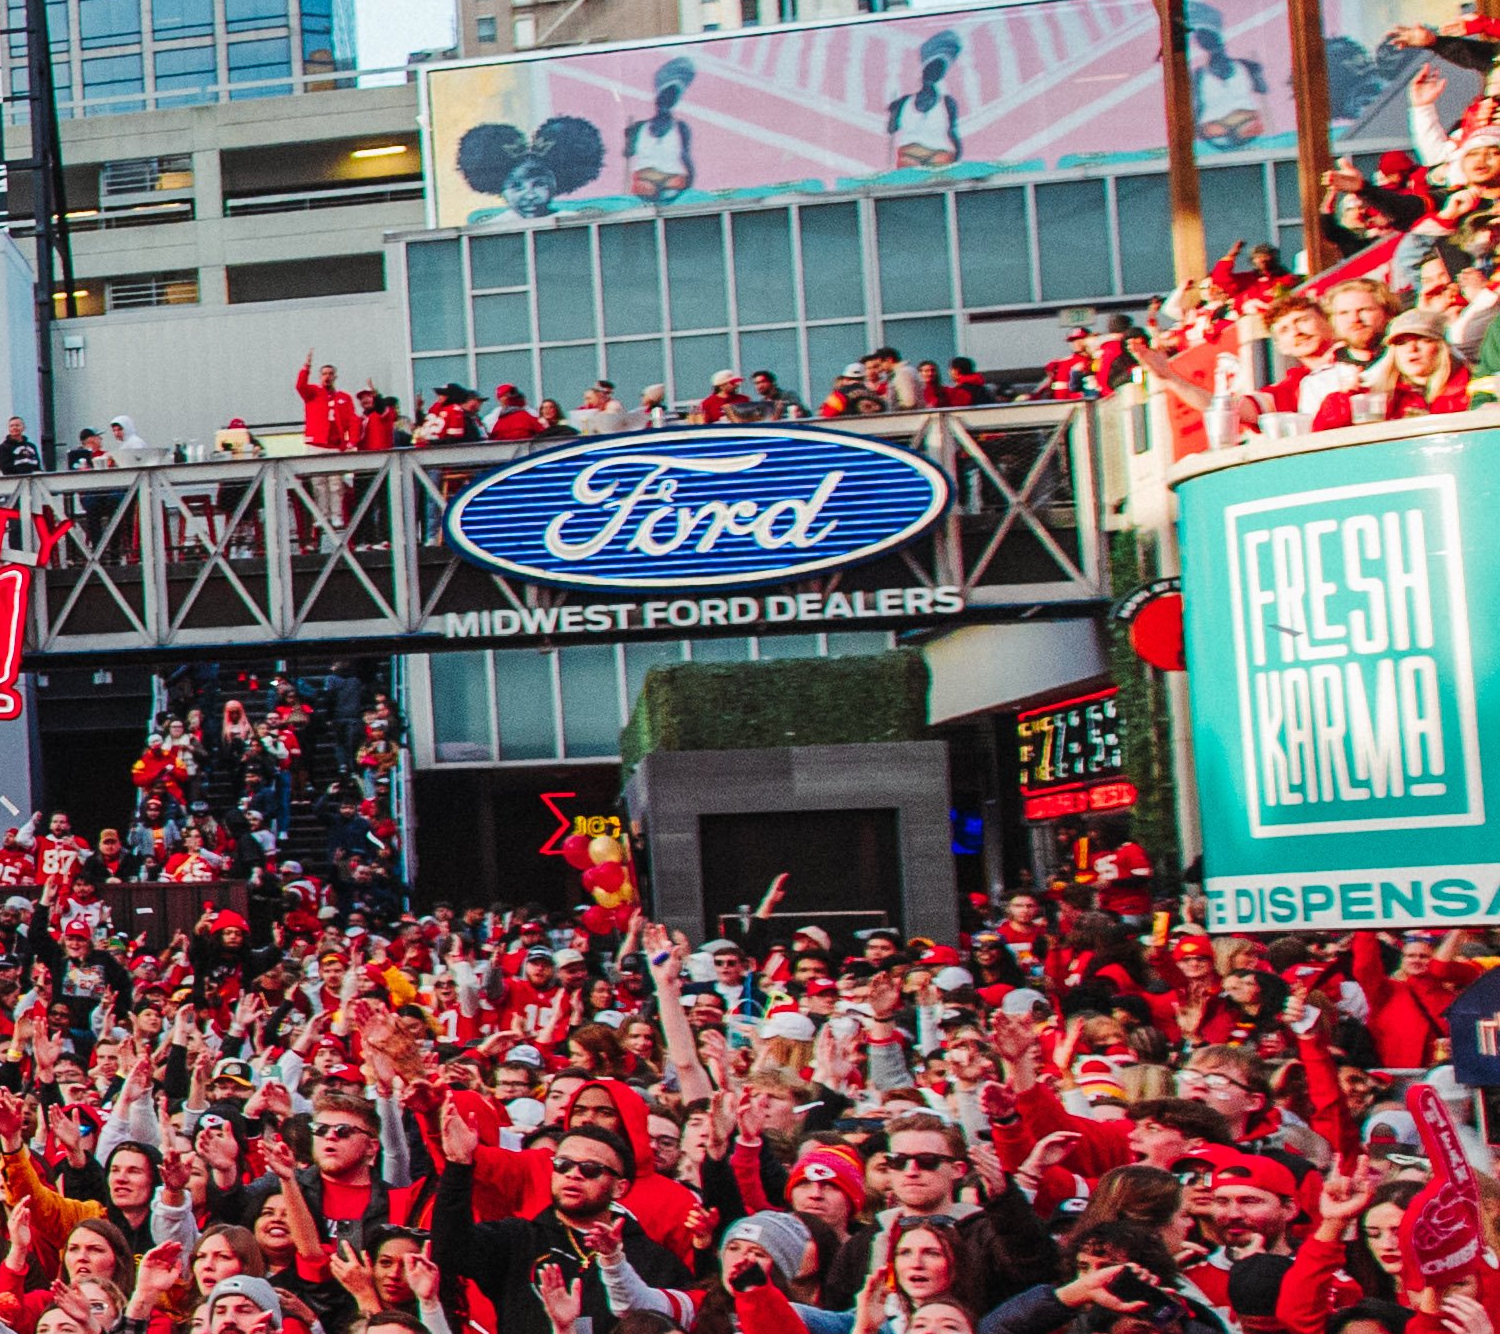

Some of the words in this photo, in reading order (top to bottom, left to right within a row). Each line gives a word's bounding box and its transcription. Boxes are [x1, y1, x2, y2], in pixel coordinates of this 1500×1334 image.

[543, 451, 845, 562] Ford
[444, 603, 637, 638] MIDWEST
[642, 594, 761, 629] FORD
[766, 584, 965, 622] DEALERS
[1243, 508, 1435, 667] FRESH
[1255, 655, 1448, 809] KARMA
